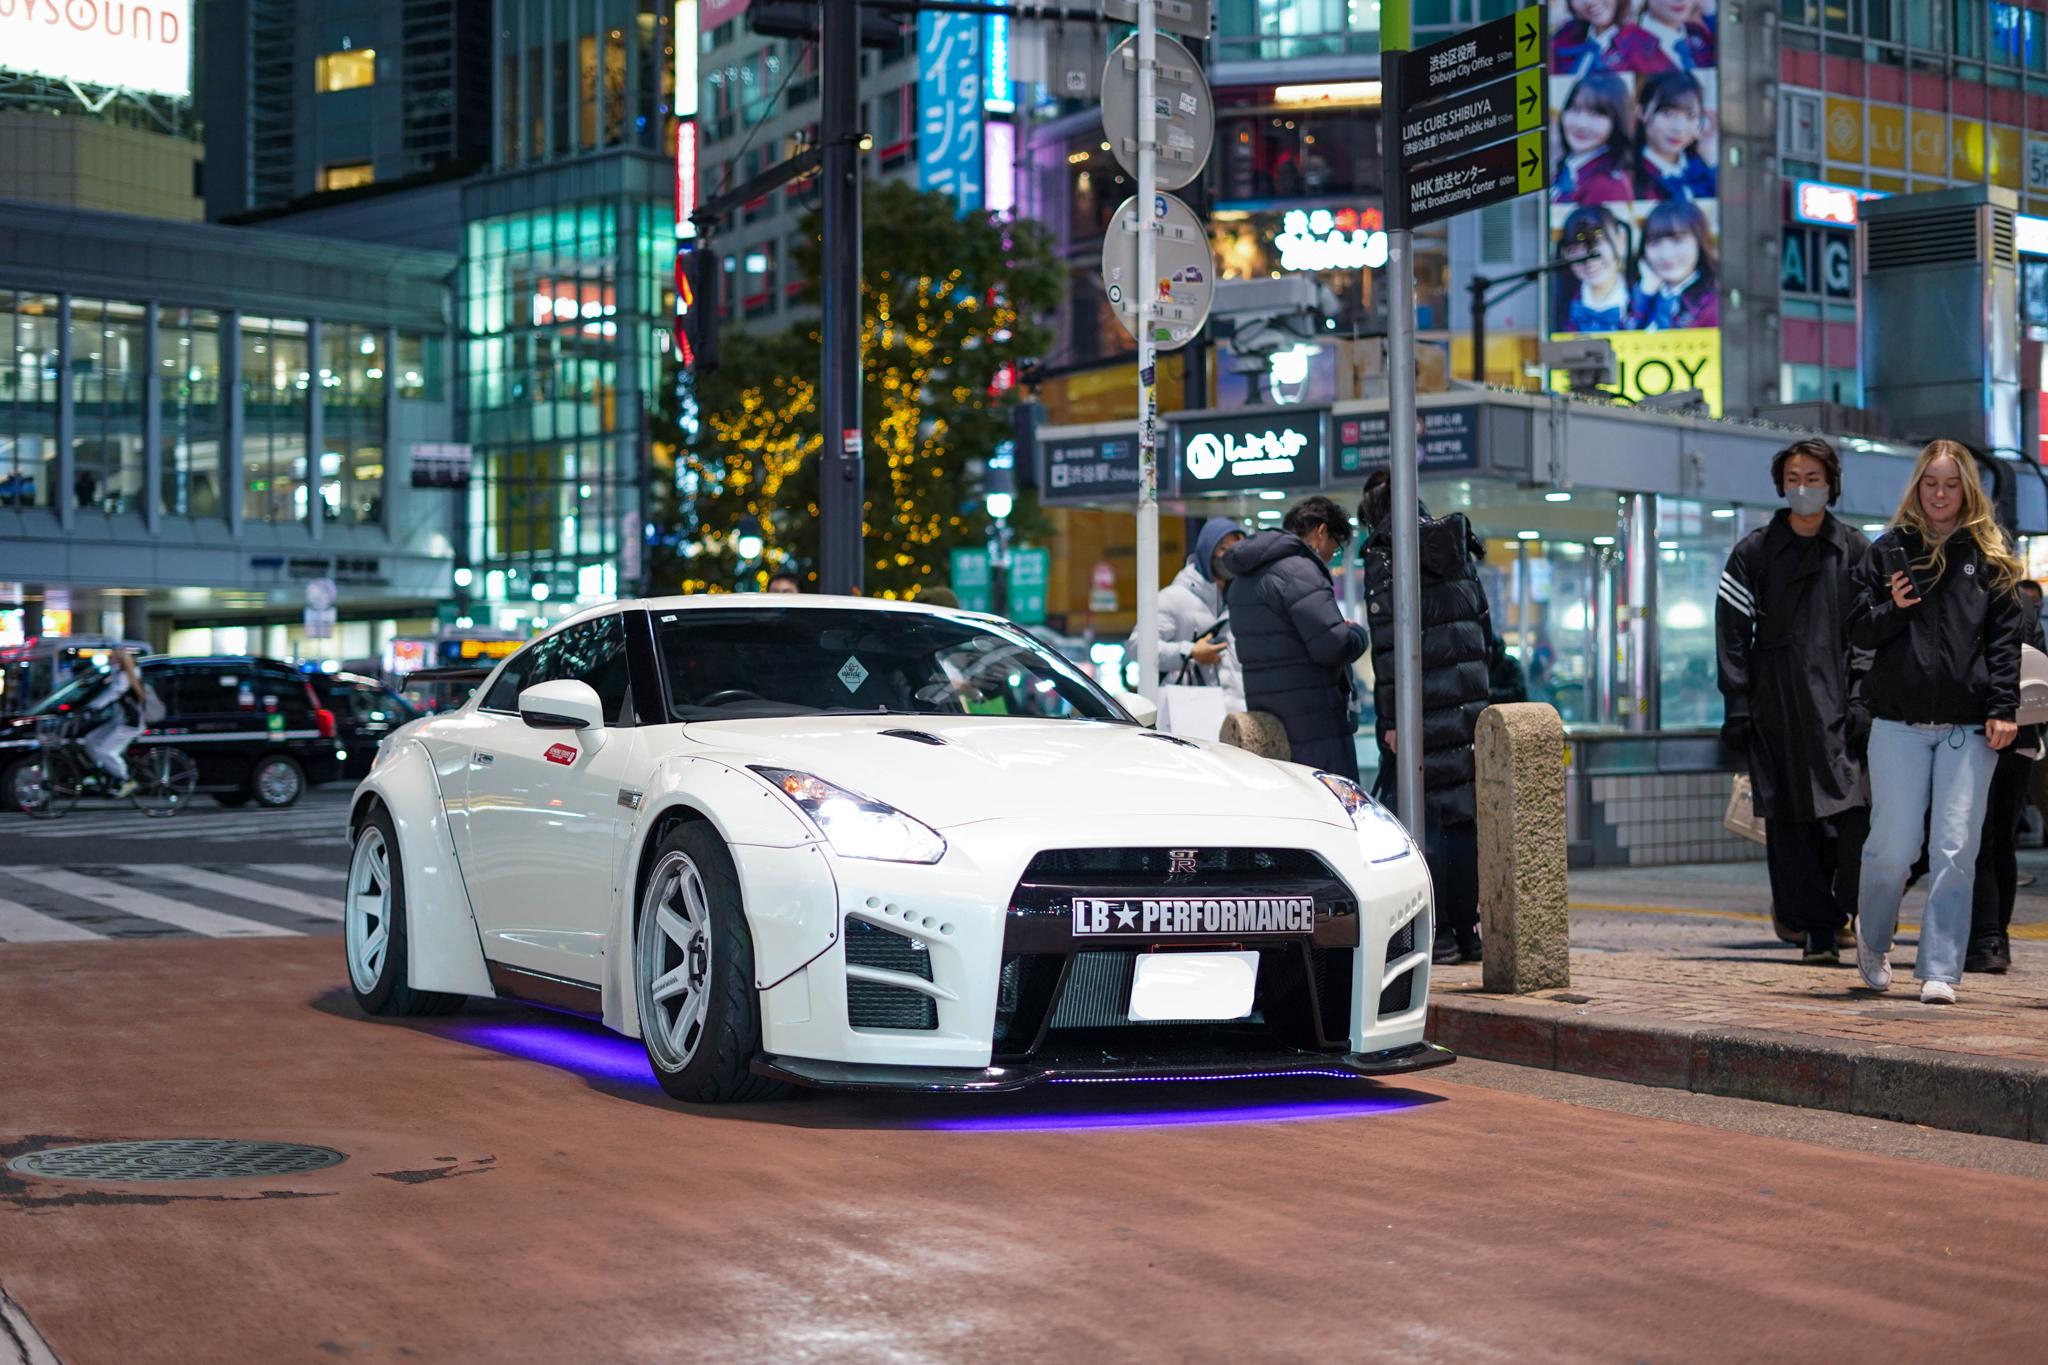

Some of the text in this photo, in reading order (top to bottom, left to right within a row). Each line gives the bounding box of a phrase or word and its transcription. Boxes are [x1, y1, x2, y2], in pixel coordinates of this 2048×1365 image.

[1429, 41, 1477, 73] 渋谷区役所
[1429, 69, 1457, 87] Shibuya
[1457, 63, 1471, 78] City
[1471, 55, 1494, 72] Office
[957, 12, 979, 210] ンタクト
[1402, 98, 1492, 141] LINE CUBE SHIBUYA
[1439, 128, 1464, 145] Shibuya
[1463, 118, 1484, 137] Public
[1484, 114, 1497, 130] Hall
[1410, 164, 1487, 200] NHK 放送センター
[1410, 199, 1428, 213] NHK
[1427, 185, 1472, 208] Broadcasting
[1471, 178, 1496, 195] Center
[1076, 900, 1312, 933] LB PERFORMANCE
